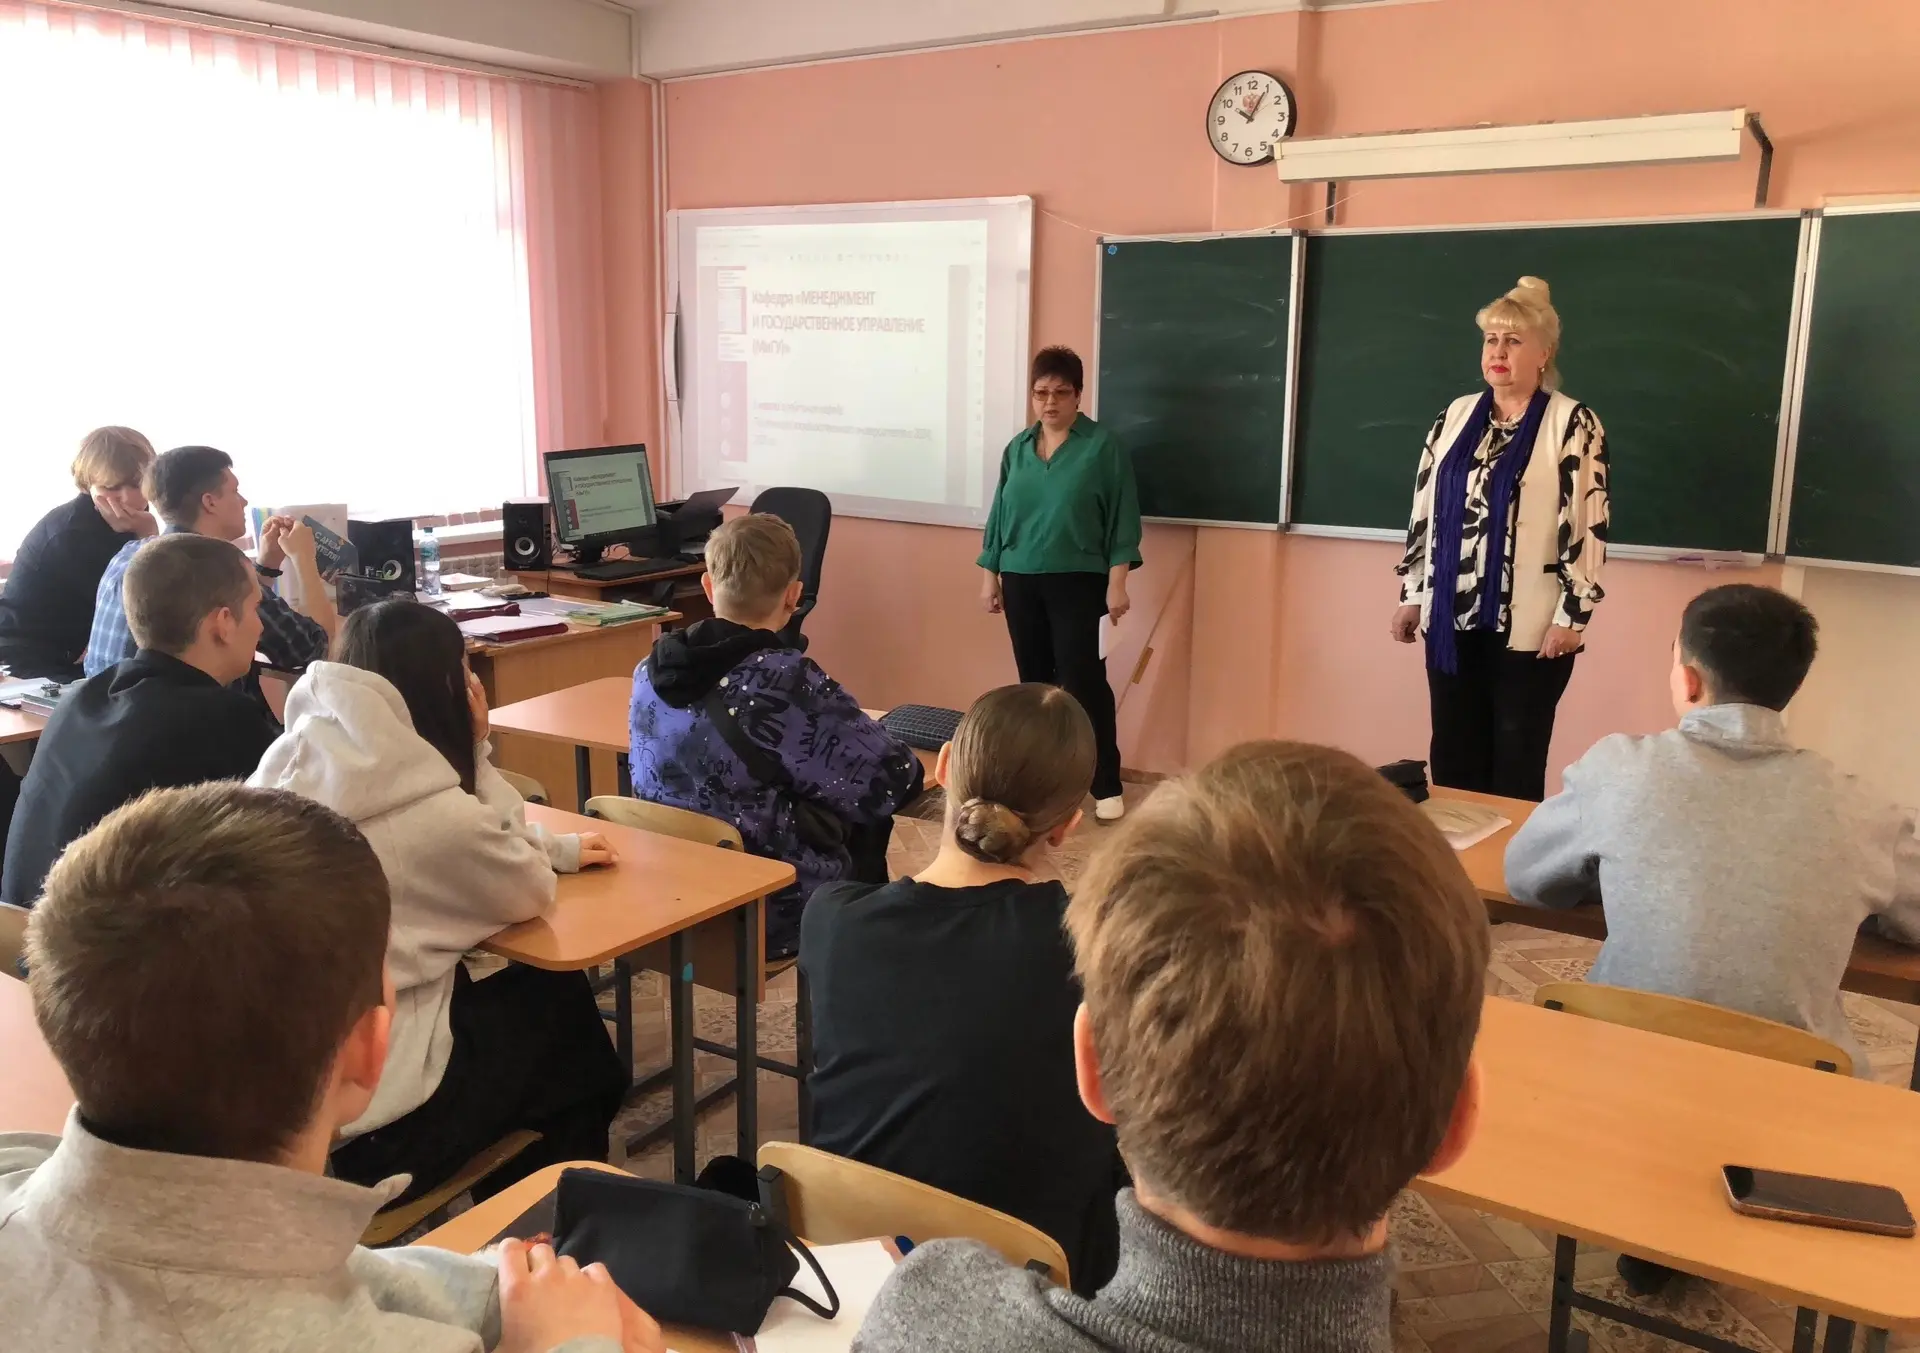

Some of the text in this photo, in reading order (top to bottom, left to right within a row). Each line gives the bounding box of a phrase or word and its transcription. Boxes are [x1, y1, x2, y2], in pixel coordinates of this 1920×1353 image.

[1247, 80, 1258, 90] 12
[1234, 86, 1242, 95] 11
[1223, 99, 1233, 108] 10
[1274, 95, 1281, 105] 2
[1217, 116, 1225, 125] 9
[1277, 112, 1285, 122] 3
[1221, 133, 1228, 141] 8
[1271, 129, 1279, 138] 4
[1232, 143, 1239, 153] 7
[1260, 141, 1267, 151] 5
[1245, 147, 1253, 157] 6
[752, 290, 793, 309] Кафедра
[761, 315, 855, 332] ГОСУДАРСТВЕННОЕ
[856, 316, 926, 334] УПРАВЛЕНИЕ
